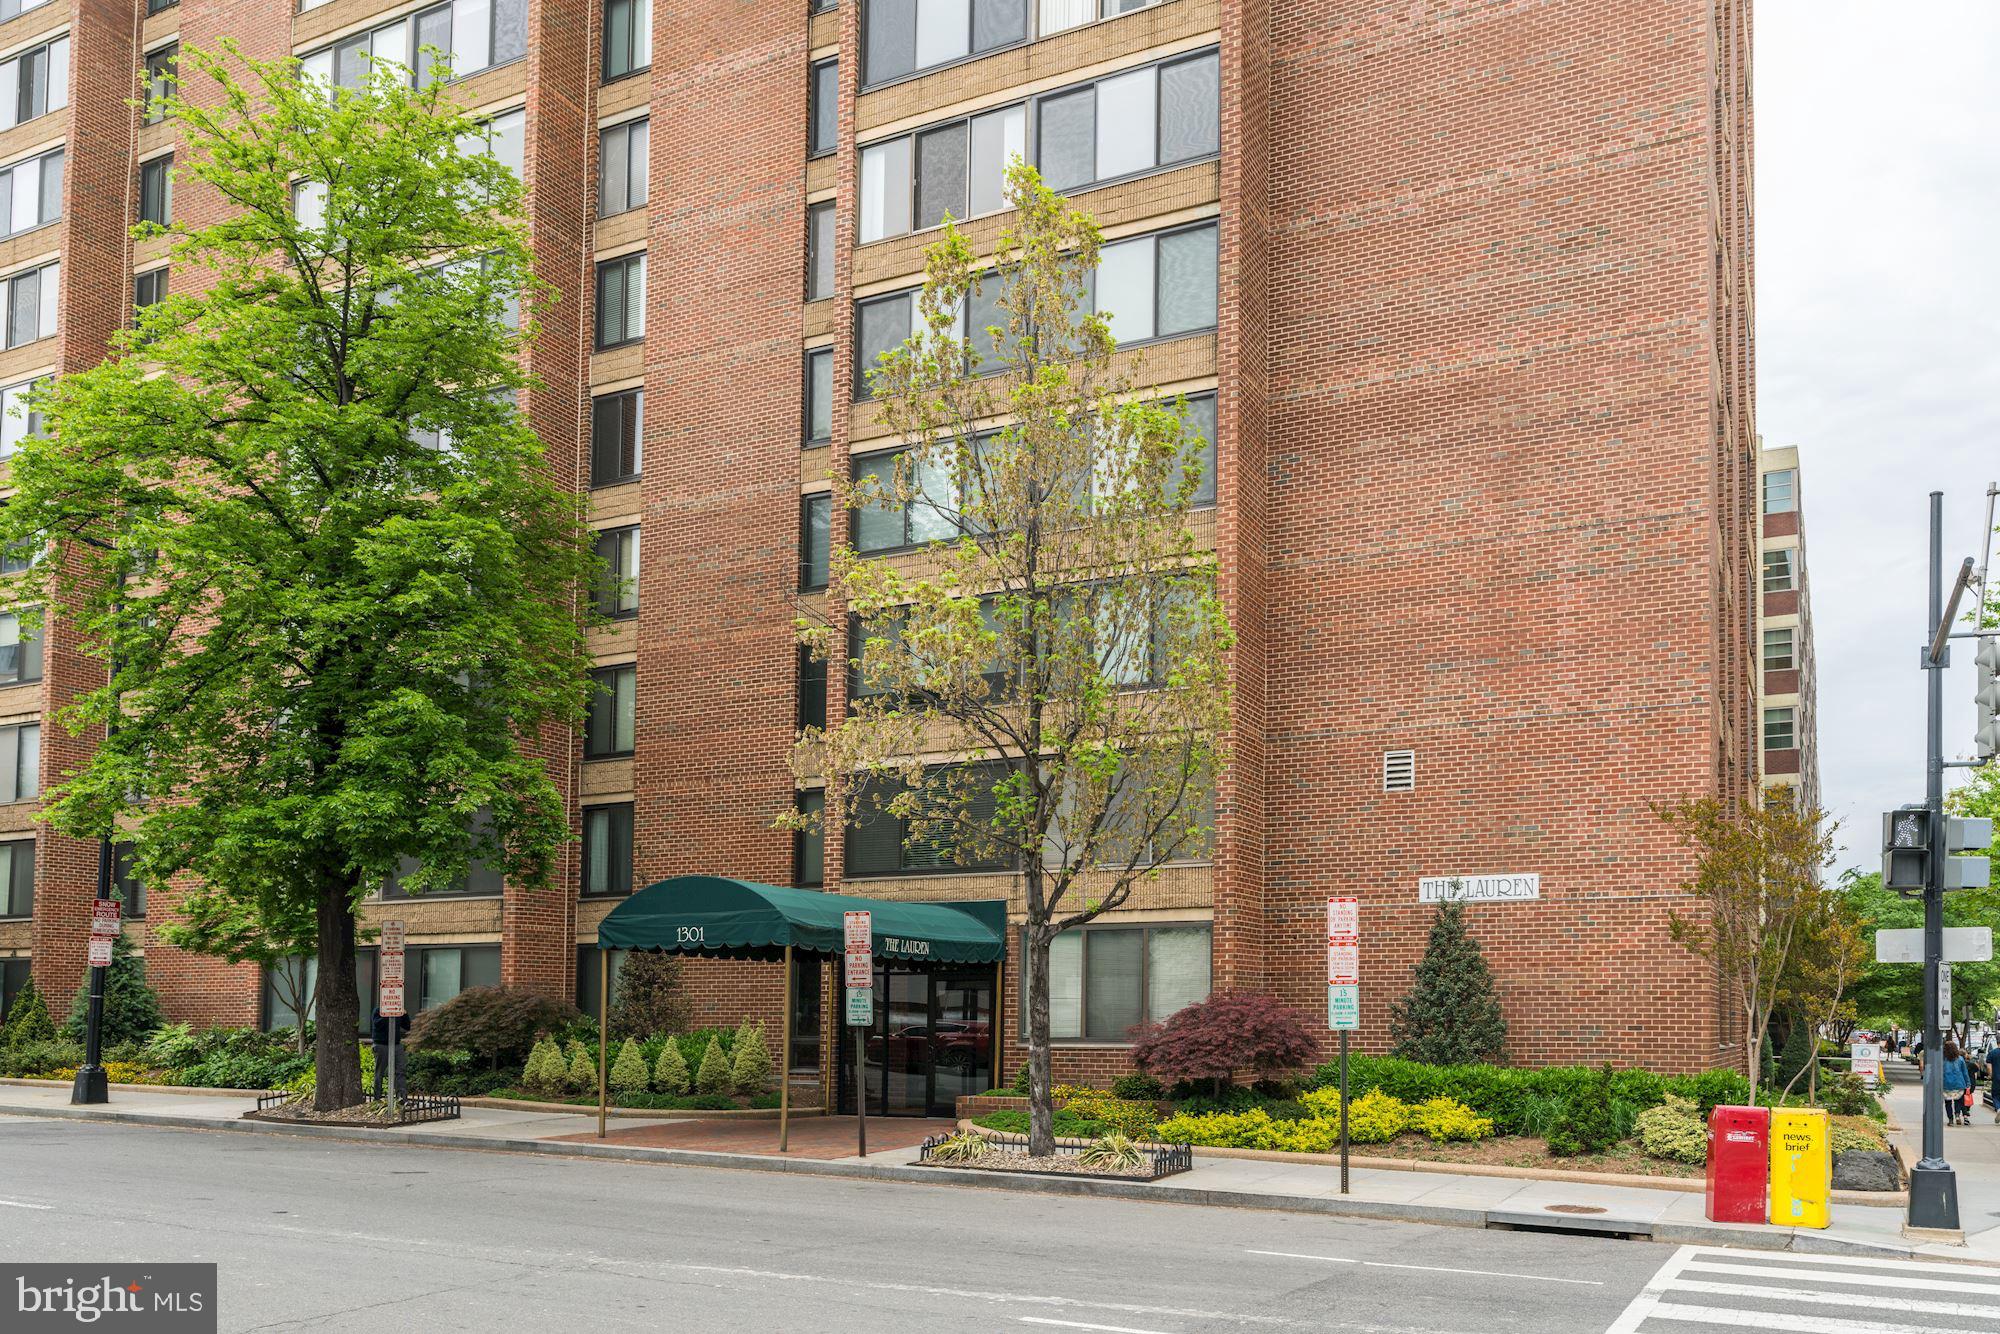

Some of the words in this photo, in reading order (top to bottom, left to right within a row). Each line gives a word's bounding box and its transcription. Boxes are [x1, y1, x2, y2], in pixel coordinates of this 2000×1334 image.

[1466, 878, 1534, 898] LAUREN
[676, 926, 704, 942] 1301
[885, 938, 899, 952] THE
[900, 940, 929, 954] LAUREN
[1941, 970, 1949, 982] ONE
[1786, 1142, 1810, 1151] brief
